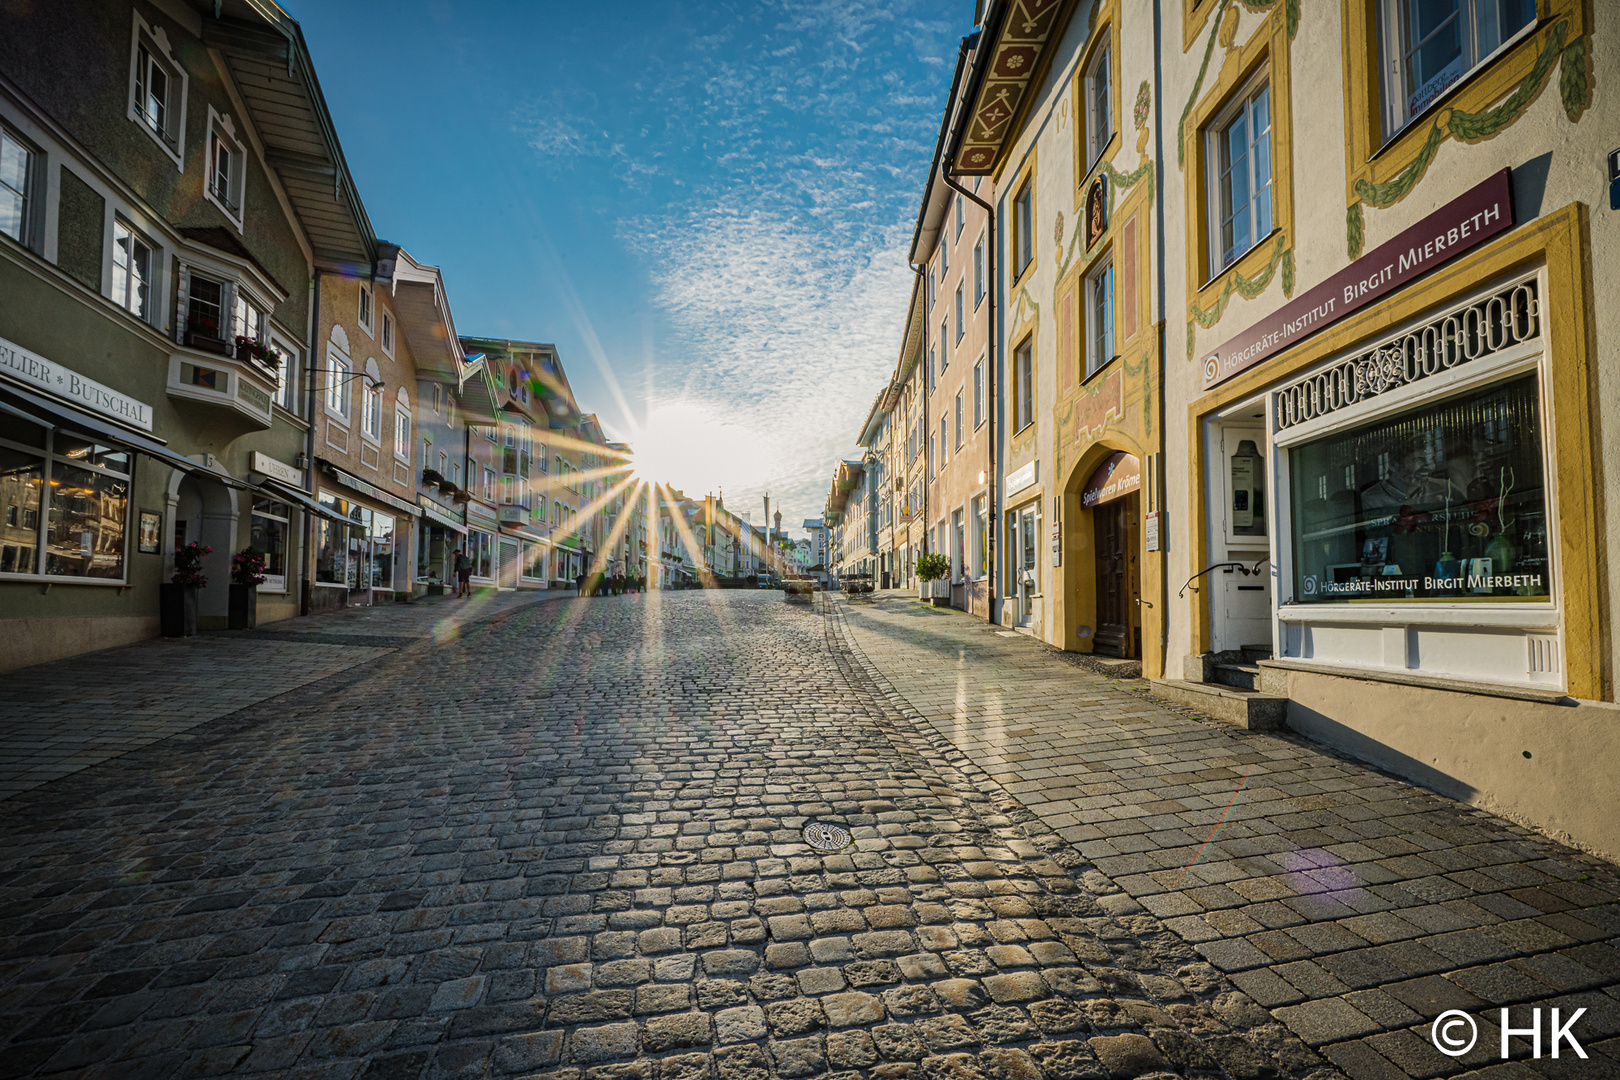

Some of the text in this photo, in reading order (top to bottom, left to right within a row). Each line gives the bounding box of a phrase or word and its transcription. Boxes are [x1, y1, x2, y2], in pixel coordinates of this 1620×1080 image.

[1223, 203, 1500, 371] HÖRGERÄTE-INSTITUT BIRGIT MIERBETH
[69, 374, 147, 424] BUTSCHAL
[208, 457, 213, 468] 3
[268, 461, 289, 478] UHREN
[1083, 483, 1116, 506] Spielwaren
[1321, 573, 1541, 592] HÖRGERÄTE-INSTITUT BIRGIT MIERBETH
